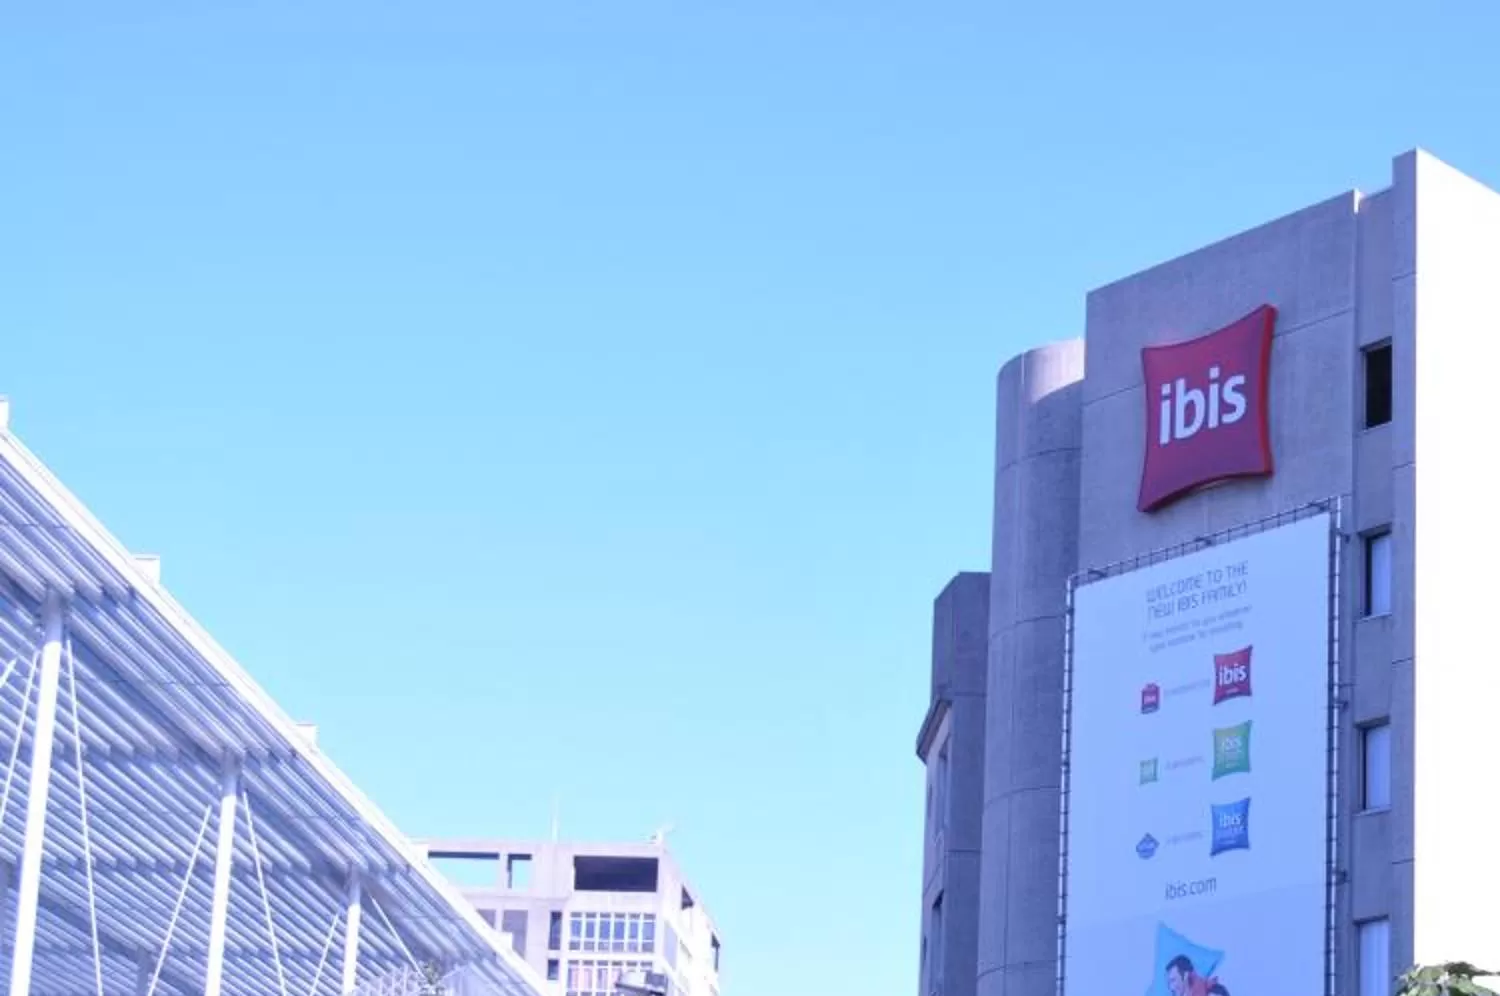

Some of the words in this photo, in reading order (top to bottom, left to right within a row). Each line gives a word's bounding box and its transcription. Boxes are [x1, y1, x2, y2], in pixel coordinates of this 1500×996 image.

[1159, 365, 1248, 445] ibis
[1206, 569, 1223, 584] TO
[1226, 560, 1249, 578] THE
[1219, 663, 1248, 686] ibis
[1165, 876, 1217, 900] ibis.com
